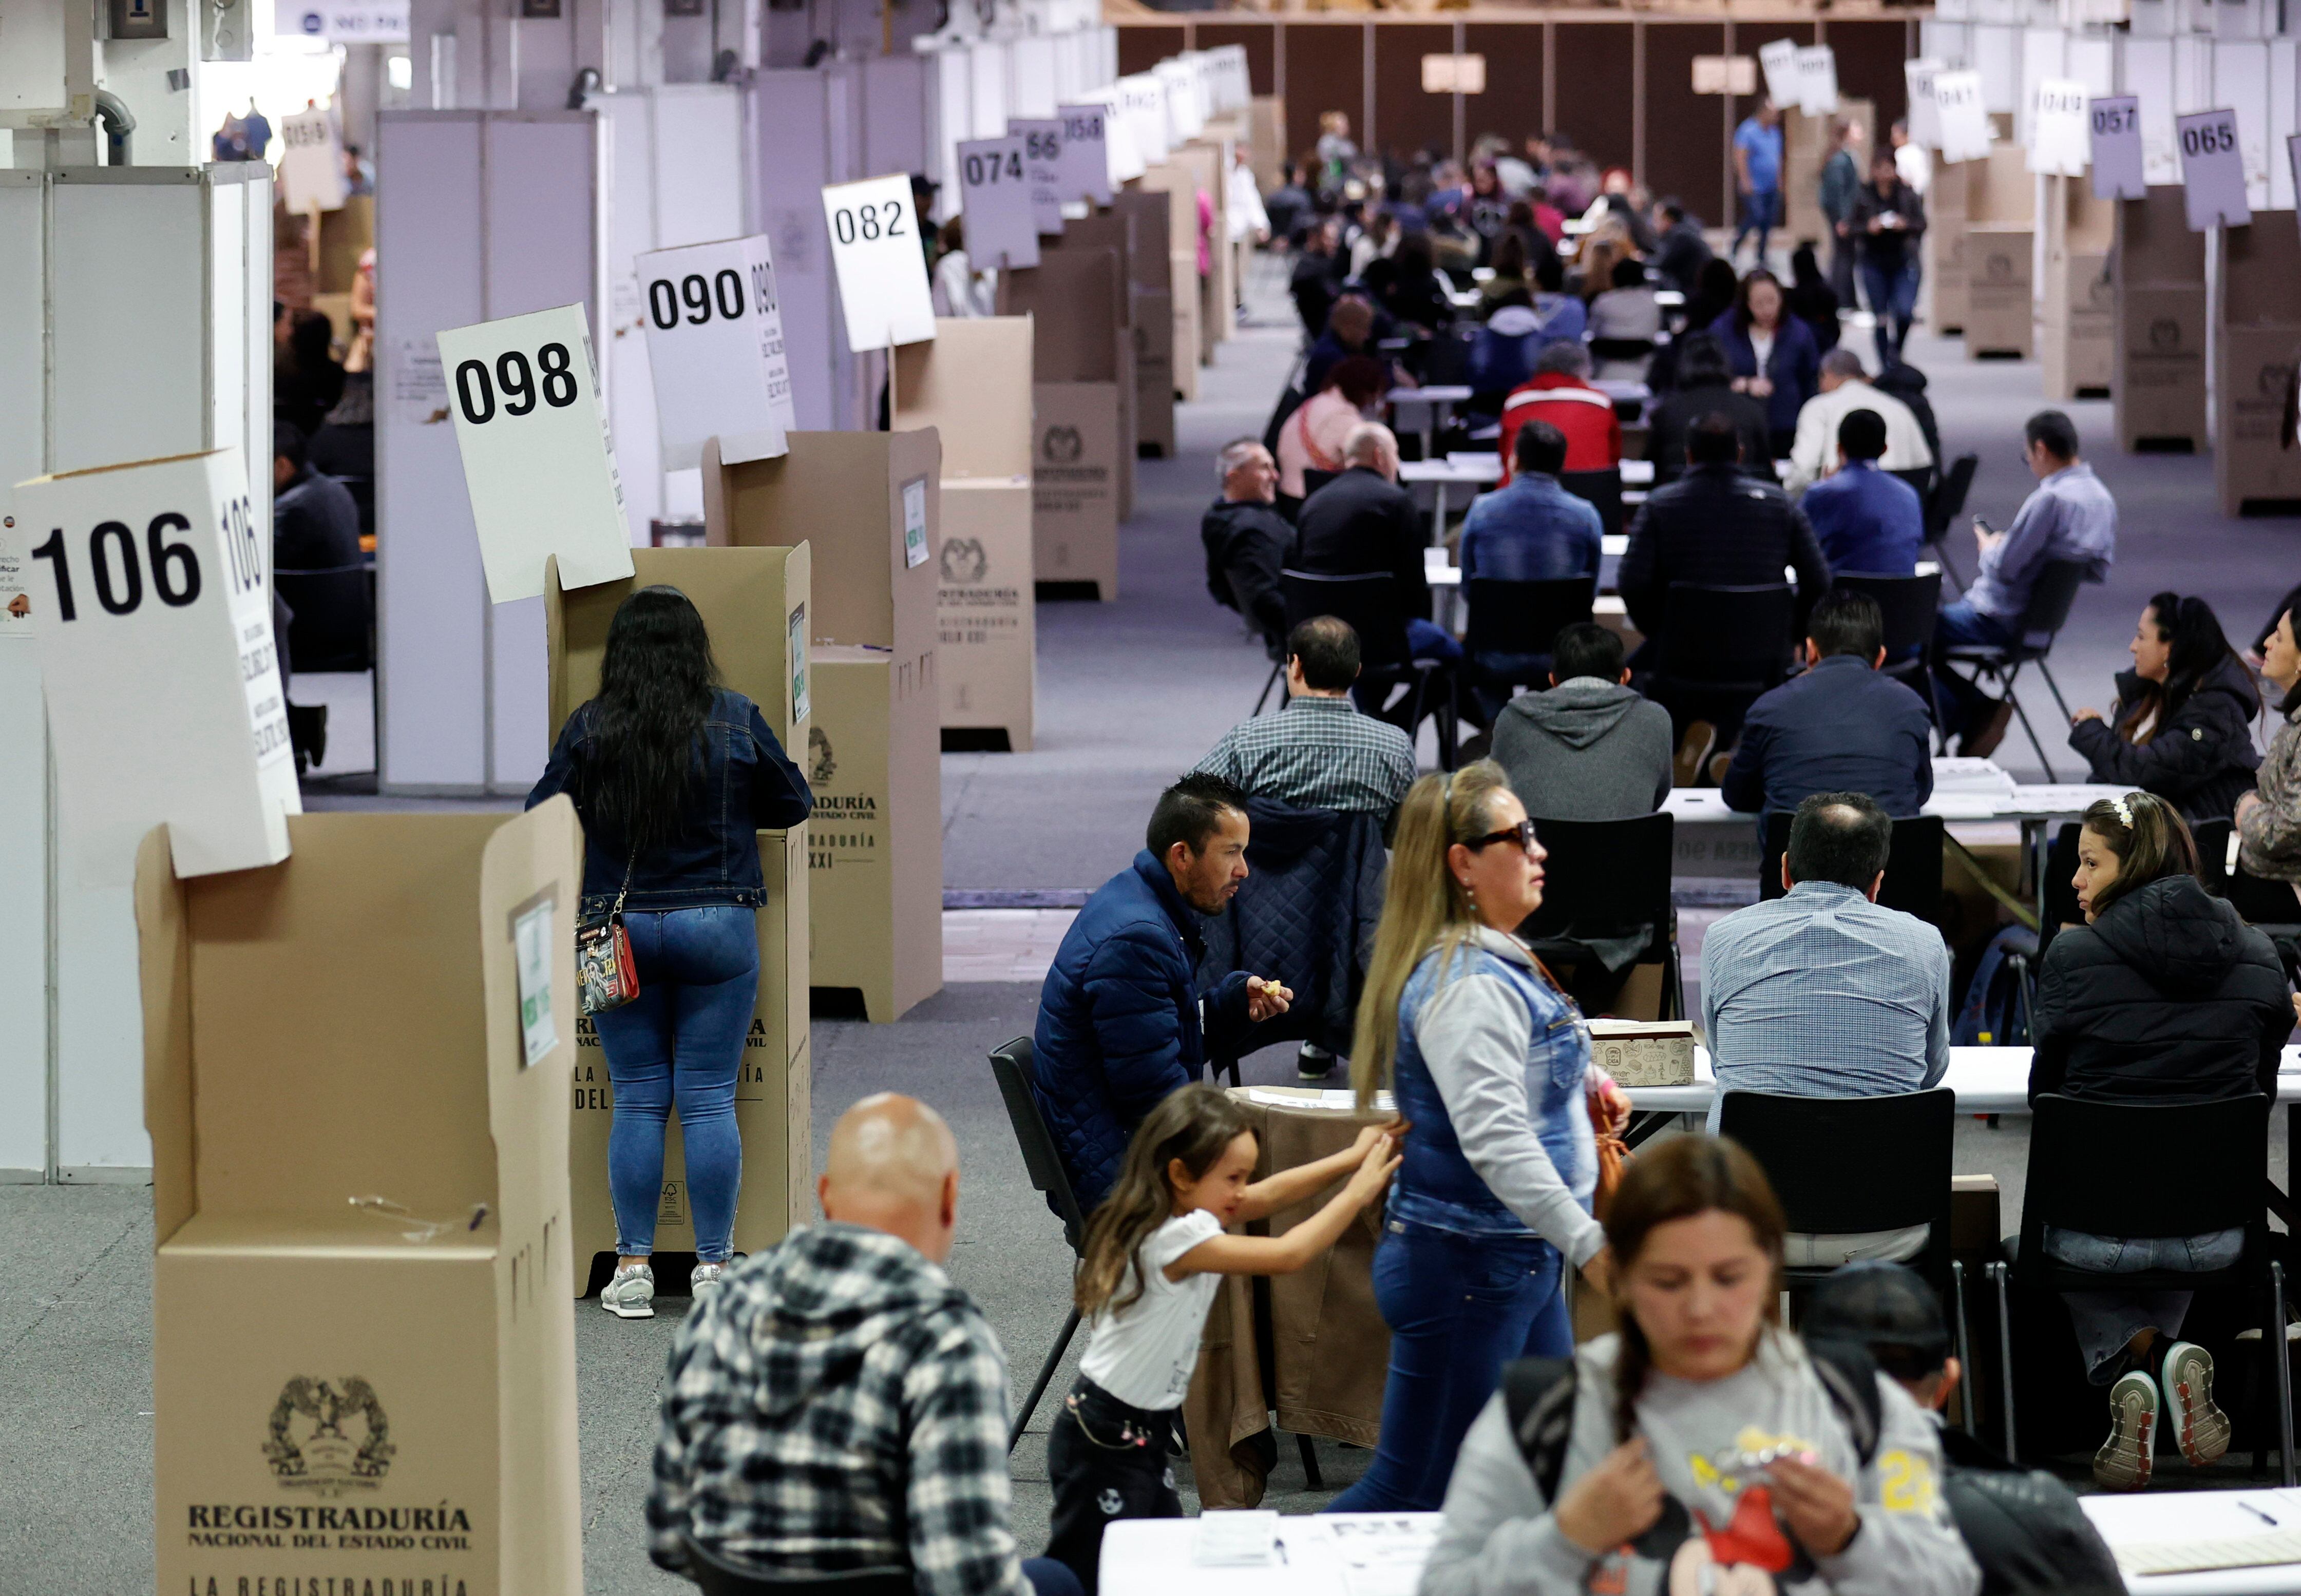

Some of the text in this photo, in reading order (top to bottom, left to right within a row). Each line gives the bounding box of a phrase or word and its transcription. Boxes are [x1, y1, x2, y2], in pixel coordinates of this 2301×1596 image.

[2183, 123, 2234, 156] 065
[965, 151, 1023, 186] 074
[835, 201, 905, 244] 082
[649, 268, 745, 330] 090
[455, 342, 578, 425] 098
[31, 512, 201, 622] 106
[575, 1066, 594, 1082] LA
[575, 1088, 608, 1110] DEL
[188, 1499, 471, 1532] REGISTRADURÍA
[188, 1533, 471, 1551] NACIONAL DEL ESTADO CIVIL
[189, 1573, 467, 1596] LA REGISTRADURÍA
